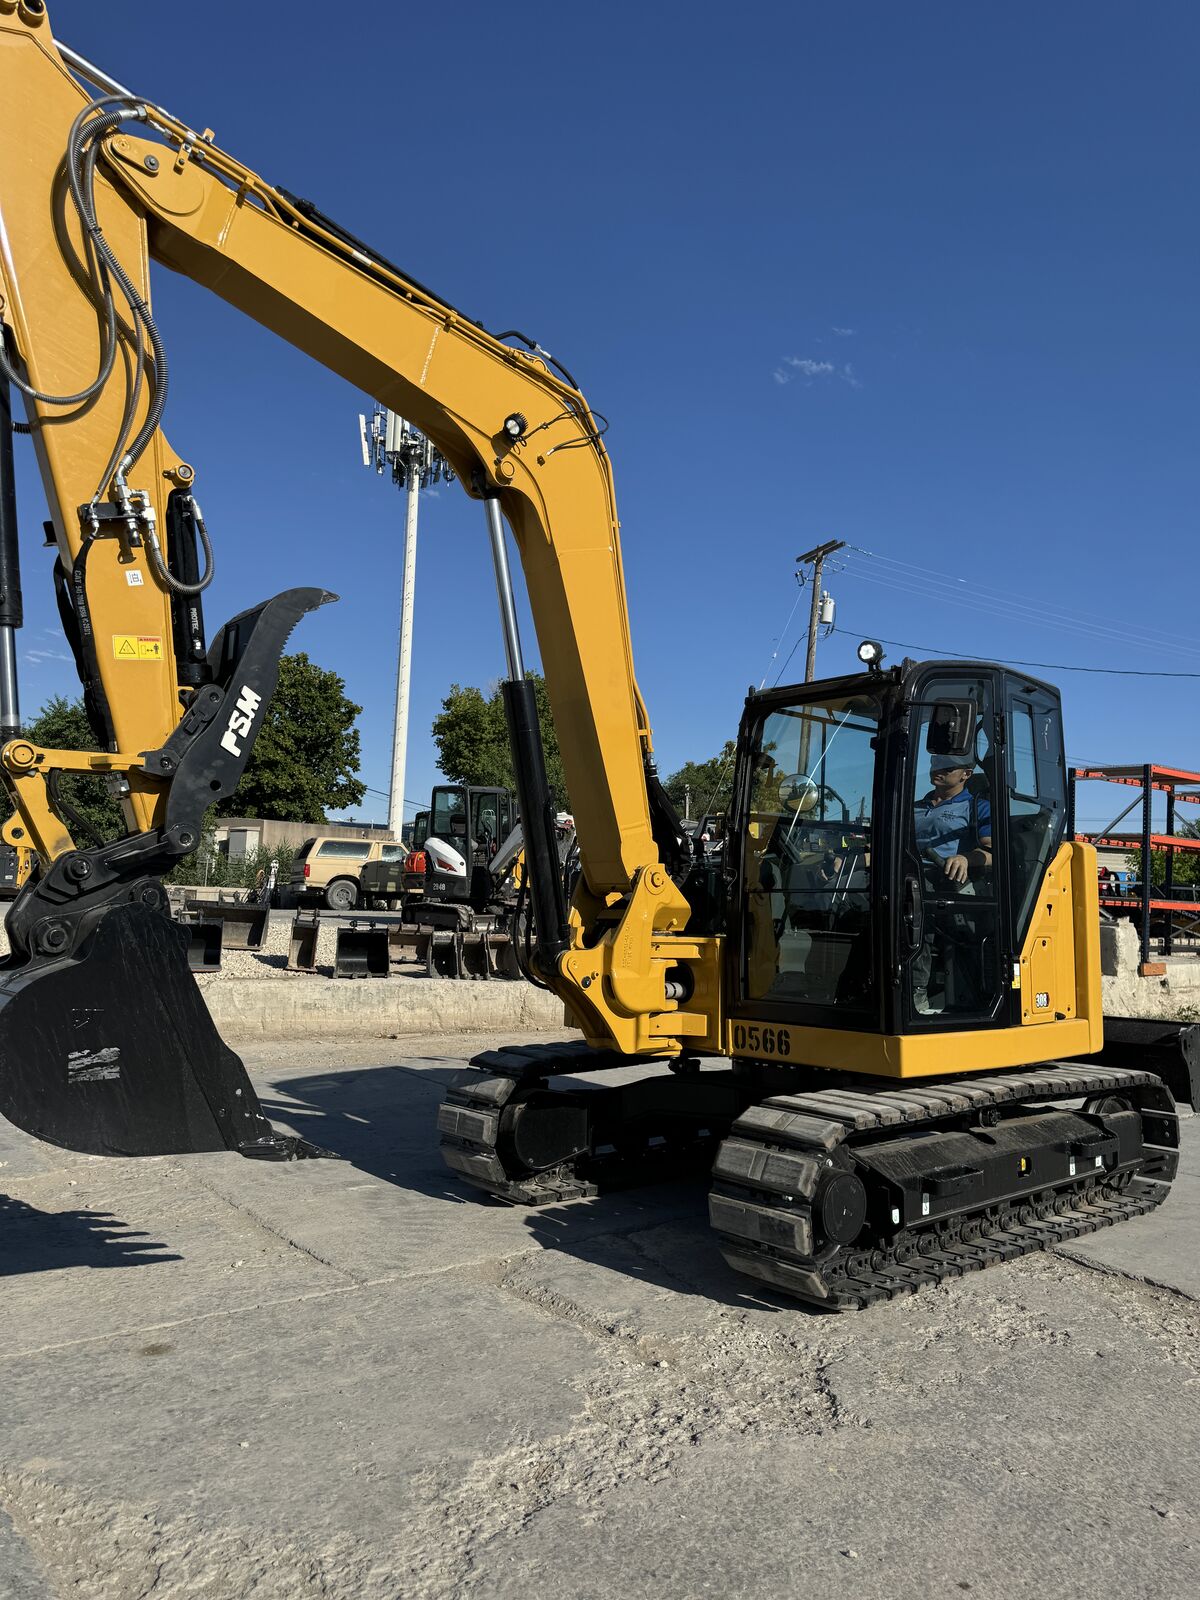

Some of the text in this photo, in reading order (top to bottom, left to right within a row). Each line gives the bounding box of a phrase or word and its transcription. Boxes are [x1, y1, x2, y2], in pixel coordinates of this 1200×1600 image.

[74, 569, 82, 584] CAT
[220, 685, 262, 757] PSM
[1035, 993, 1048, 1008] 308
[734, 1024, 790, 1056] 0566
